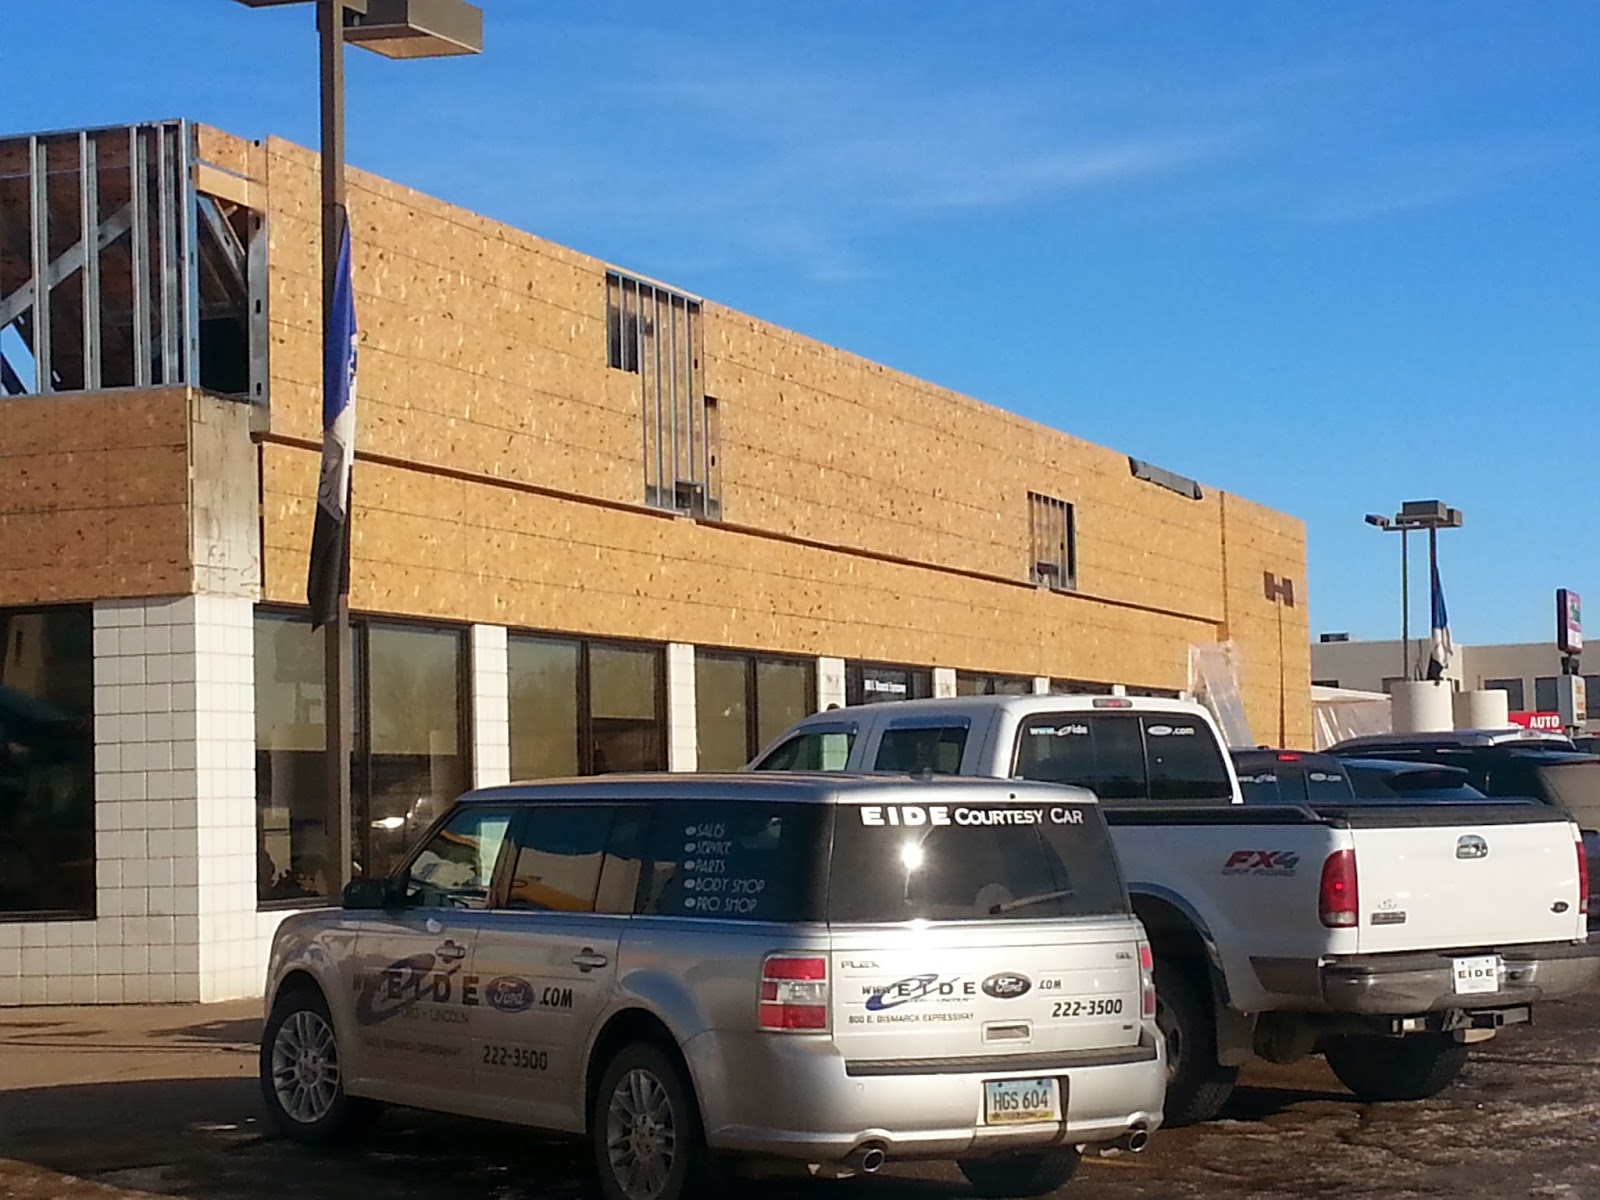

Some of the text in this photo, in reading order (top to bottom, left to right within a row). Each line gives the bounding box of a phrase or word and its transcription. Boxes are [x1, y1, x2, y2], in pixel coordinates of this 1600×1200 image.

[1530, 715, 1560, 728] AUTO
[860, 805, 951, 826] EIDE
[1050, 807, 1084, 824] CAR
[696, 823, 727, 837] SALES
[695, 859, 726, 873] PARTS
[1224, 850, 1299, 868] FX4
[695, 877, 765, 893] BODY SHOP
[696, 896, 757, 912] PRO SHOP
[841, 961, 880, 969] FLEX
[1458, 968, 1494, 979] EIDE
[387, 971, 480, 1006] EIDE
[494, 981, 526, 1004] Ford
[539, 986, 573, 1008] .COM
[897, 981, 977, 996] EIDE
[995, 976, 1024, 993] Ford
[1052, 999, 1123, 1018] 222-3500
[848, 1015, 864, 1024] 800
[877, 1014, 919, 1023] BISMARCK
[922, 1012, 975, 1022] EXPRESSWAY
[483, 1045, 548, 1071] 222-3500
[993, 1089, 1049, 1111] HGS 604
